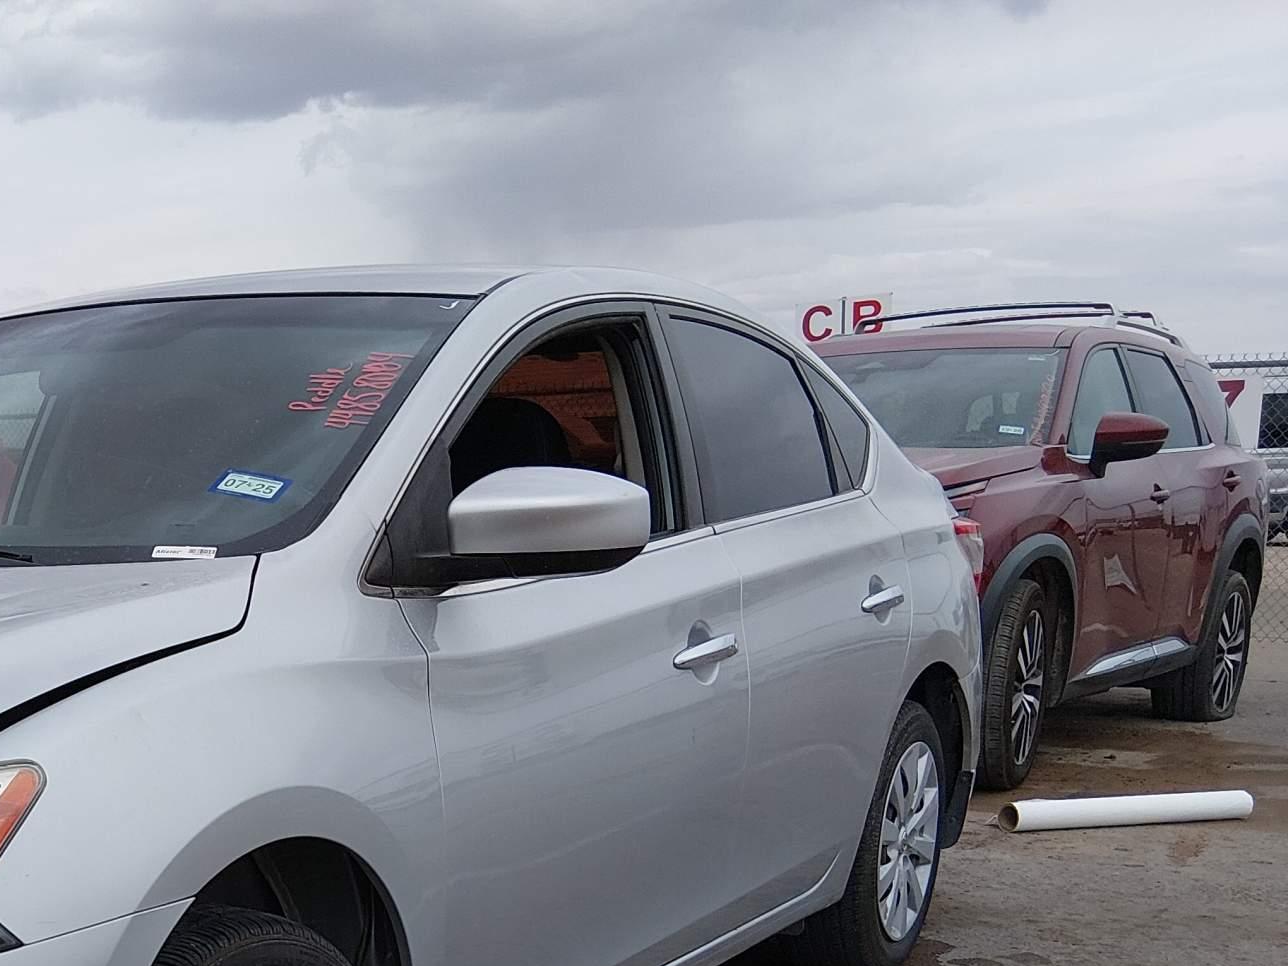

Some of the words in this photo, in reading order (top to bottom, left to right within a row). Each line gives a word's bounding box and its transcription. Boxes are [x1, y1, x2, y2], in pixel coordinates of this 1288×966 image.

[802, 305, 833, 342] C
[853, 300, 884, 334] B
[224, 477, 247, 489] 07
[252, 483, 276, 495] 25
